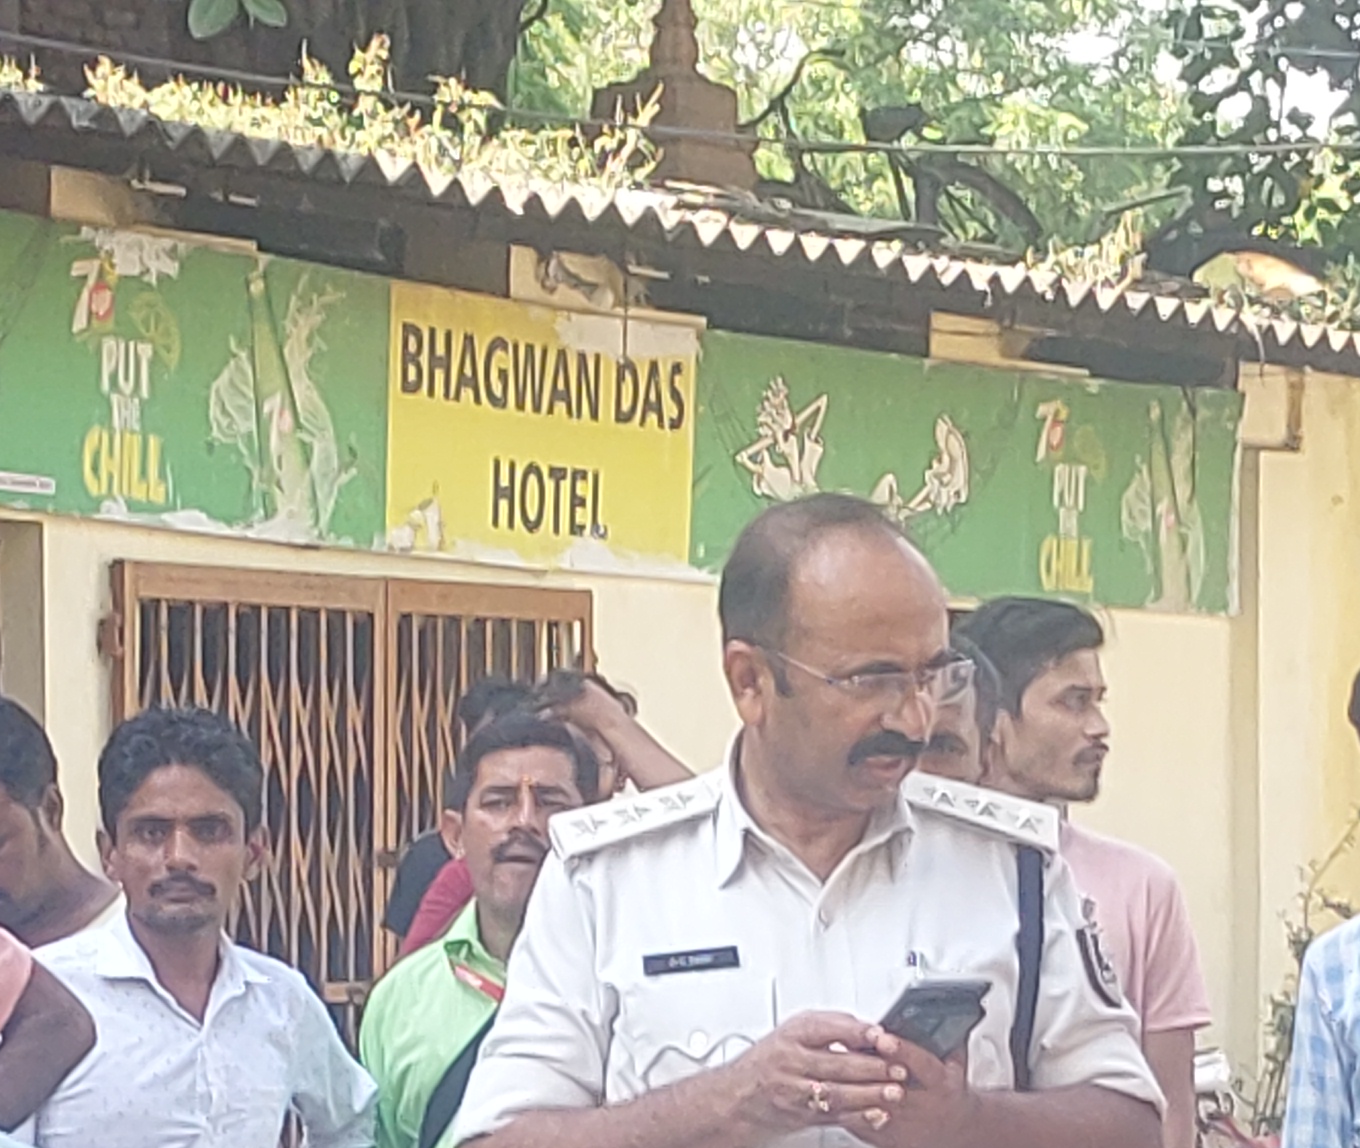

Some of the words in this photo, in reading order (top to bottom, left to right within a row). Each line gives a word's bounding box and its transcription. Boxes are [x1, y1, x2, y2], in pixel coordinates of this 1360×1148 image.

[101, 334, 153, 399] PUT
[401, 321, 601, 422] BHAGWAN
[614, 357, 685, 430] DAS
[83, 425, 166, 503] CHILL
[491, 456, 608, 540] HOTEL
[1053, 463, 1087, 512] PUT
